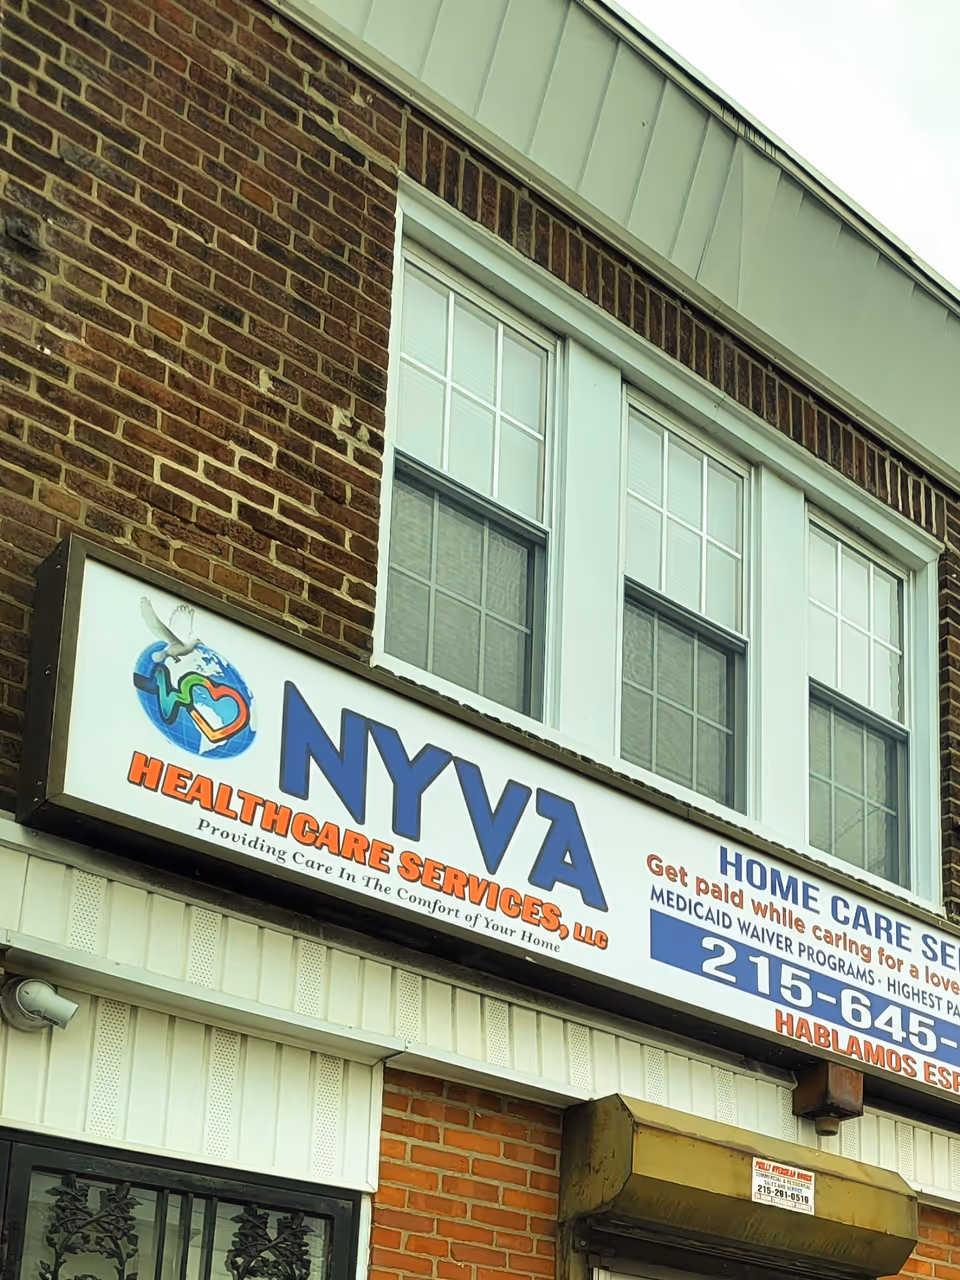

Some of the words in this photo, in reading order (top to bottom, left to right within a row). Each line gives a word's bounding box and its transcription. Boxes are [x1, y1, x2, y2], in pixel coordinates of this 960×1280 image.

[127, 751, 394, 873] HEALTHCARE
[397, 851, 569, 940] SERVICES,
[573, 922, 609, 950] LLC
[279, 680, 609, 913] NYVA
[196, 818, 287, 863] Providing
[292, 851, 333, 875] Care
[338, 866, 357, 884] In
[362, 874, 392, 895] The
[397, 887, 461, 919] Comfort
[465, 913, 483, 928] of
[483, 917, 517, 937] Your
[520, 930, 561, 953] Home
[646, 854, 688, 887] Get
[696, 876, 744, 909] paid
[751, 898, 806, 933] while
[812, 925, 872, 964] caring
[878, 947, 903, 972] for
[910, 964, 919, 979] a
[650, 884, 733, 930] MEDICAID
[738, 917, 793, 955] WAIVER
[799, 942, 875, 986] PROGRAMS
[887, 979, 942, 1011] HIGHEST
[720, 846, 820, 914] HOME
[831, 895, 912, 952] CARE
[775, 1008, 917, 1078] HABLAMOS
